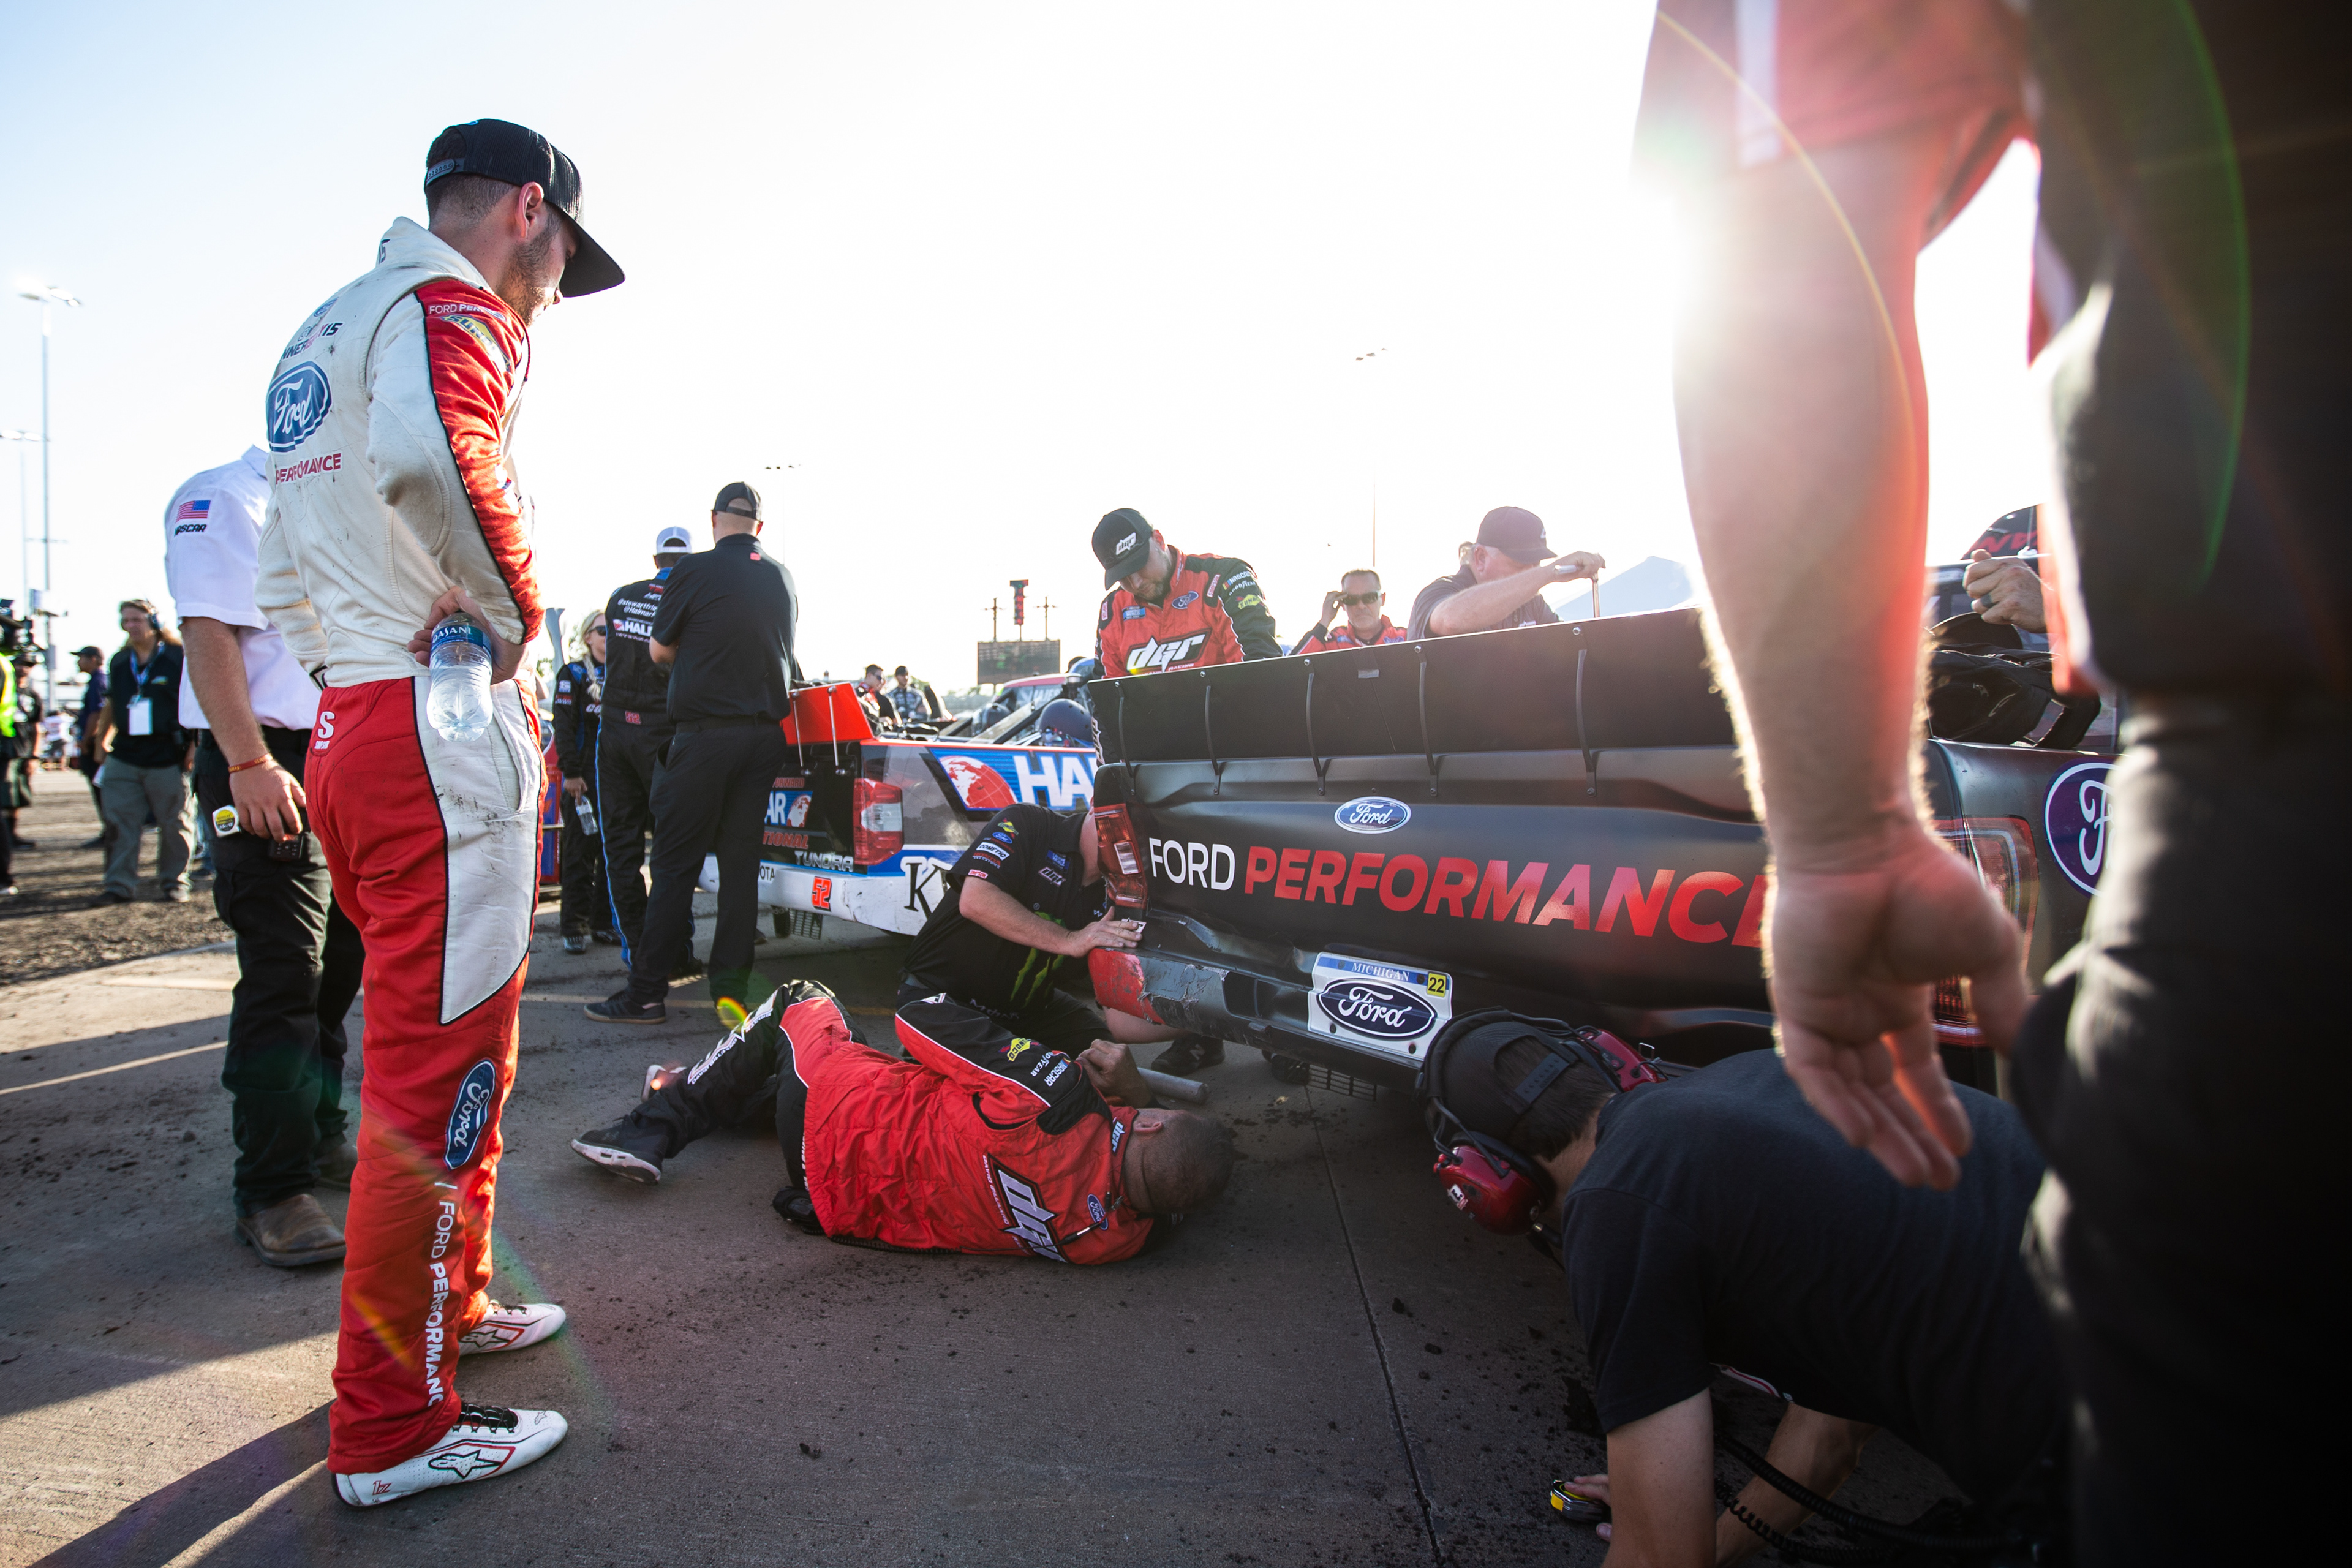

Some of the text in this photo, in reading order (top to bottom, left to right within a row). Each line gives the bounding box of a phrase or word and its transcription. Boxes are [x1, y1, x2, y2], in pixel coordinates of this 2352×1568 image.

[429, 304, 457, 314] FORD
[273, 377, 313, 435] Ford
[432, 626, 473, 644] DASANI
[1349, 804, 1393, 824] Ford
[794, 850, 854, 873] TUNDRA
[979, 844, 1006, 858] COMETIC
[1149, 837, 1235, 891] FORD
[811, 876, 832, 912] 52
[1351, 962, 1410, 981] MICHIGAN
[1428, 976, 1446, 993] 22
[1338, 987, 1412, 1028] Ford
[454, 1082, 489, 1147] Ford
[431, 1200, 455, 1259] FORD
